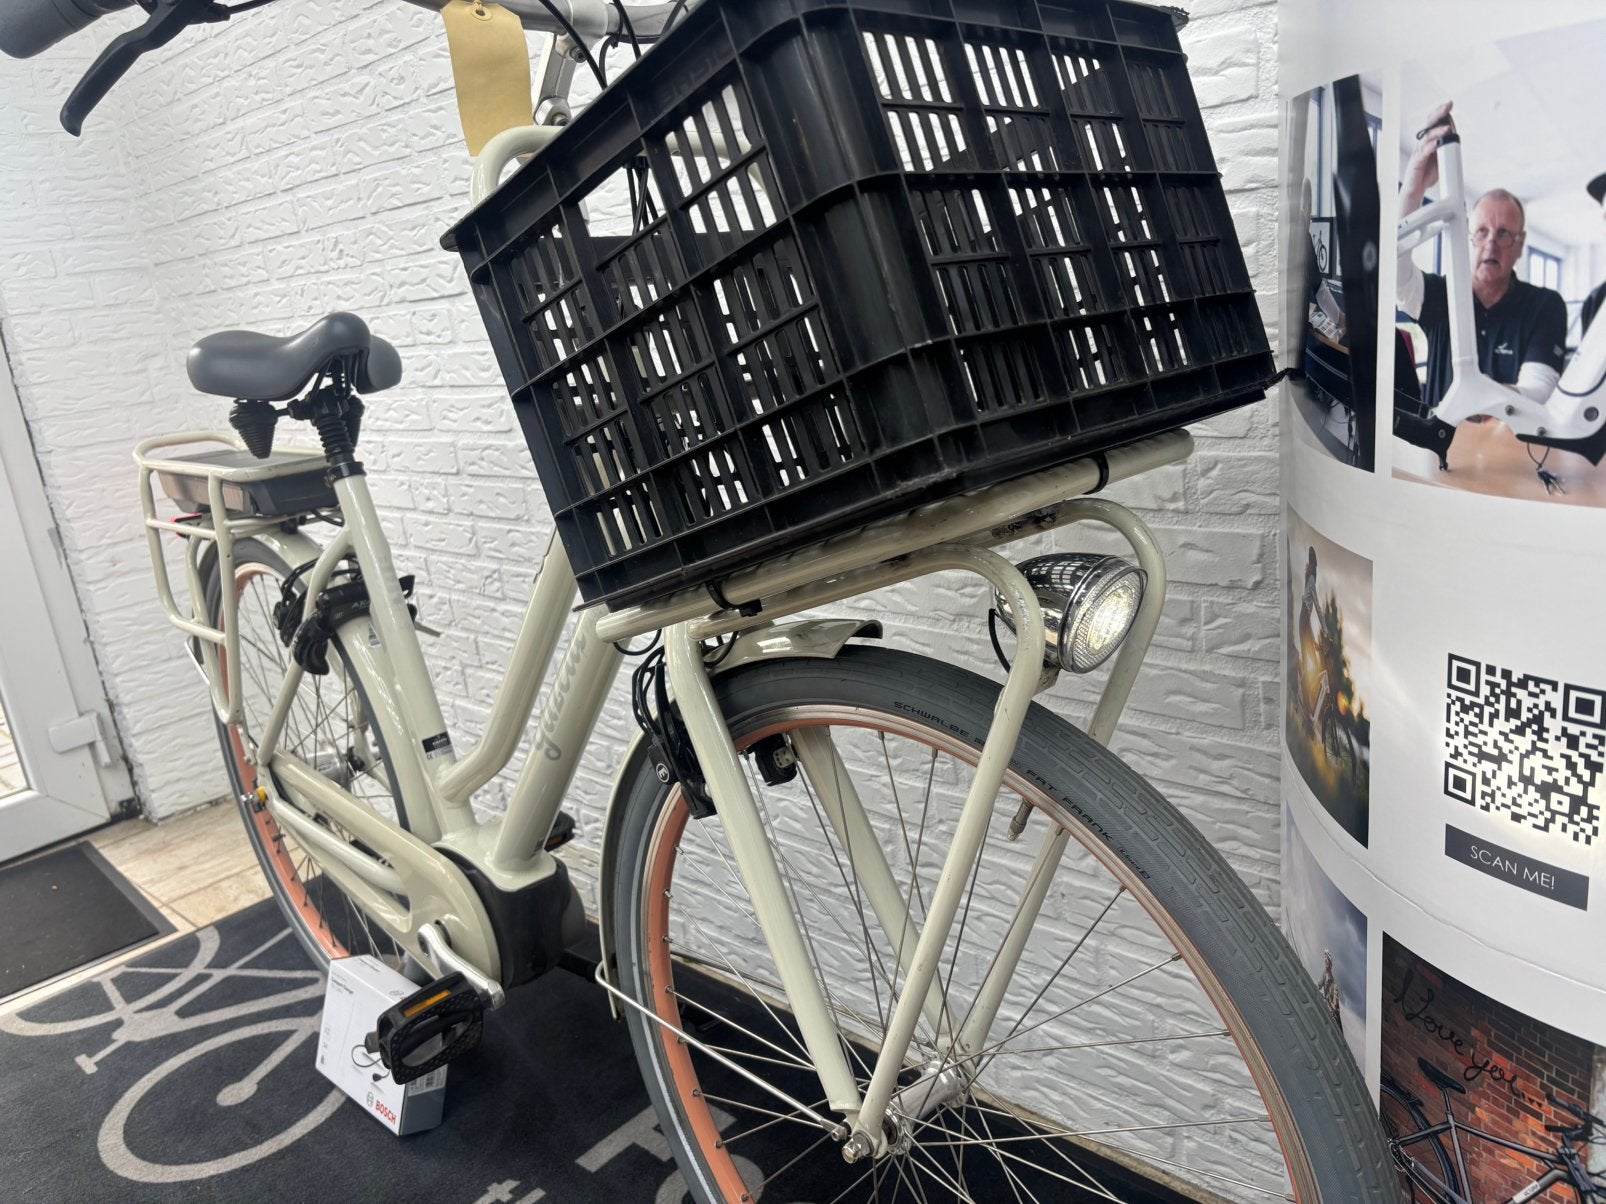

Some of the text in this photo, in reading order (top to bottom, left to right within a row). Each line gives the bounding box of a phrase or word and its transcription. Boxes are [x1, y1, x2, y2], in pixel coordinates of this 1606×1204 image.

[894, 701, 970, 737] SCHWALBE
[1026, 769, 1057, 791] FAT
[1062, 797, 1114, 841] FRANK
[1470, 845, 1555, 890] SCAN ME!
[375, 1099, 397, 1125] BOSCH
